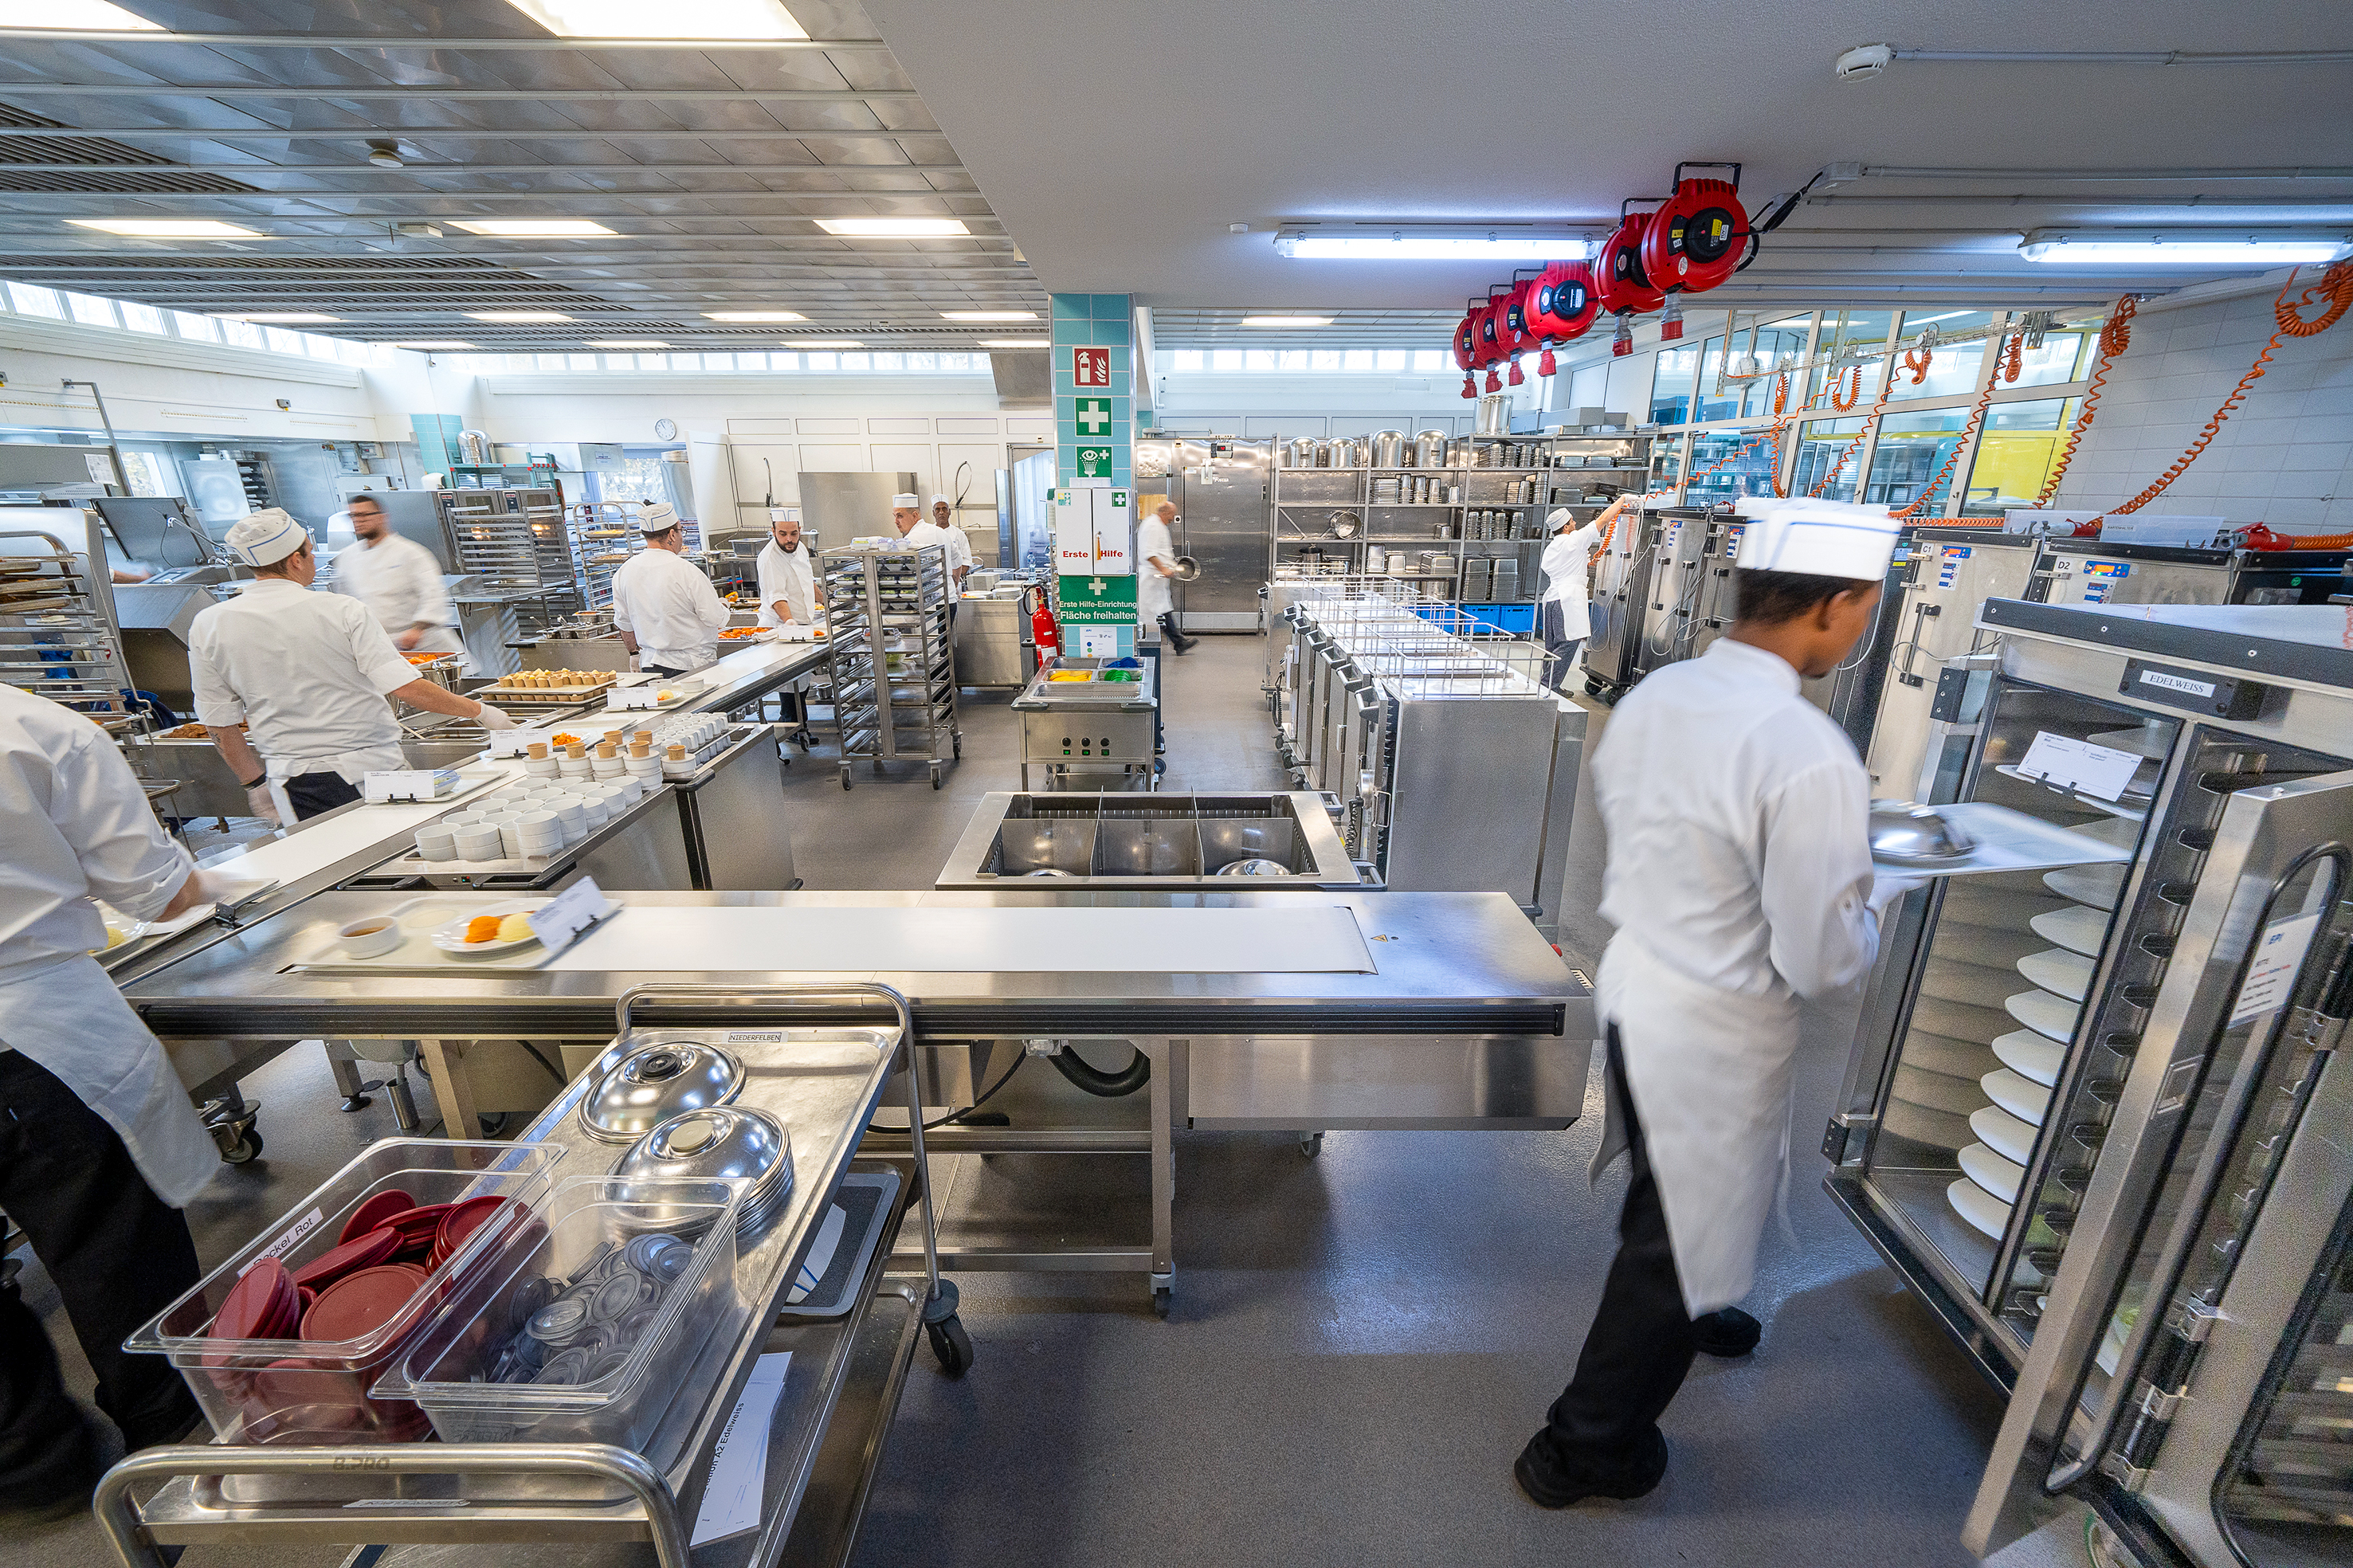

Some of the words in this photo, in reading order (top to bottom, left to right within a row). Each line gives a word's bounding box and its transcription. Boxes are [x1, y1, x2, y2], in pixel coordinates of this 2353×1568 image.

[2058, 561, 2070, 570] D2
[1079, 600, 1137, 609] Hilfe-Einrichtung
[1061, 610, 1091, 619] Fläche
[1093, 610, 1136, 619] freihalten
[2150, 675, 2204, 693] EDELWEISS
[295, 1217, 313, 1236] Rot
[715, 1446, 725, 1459] A2
[720, 1402, 744, 1445] Edelweiss
